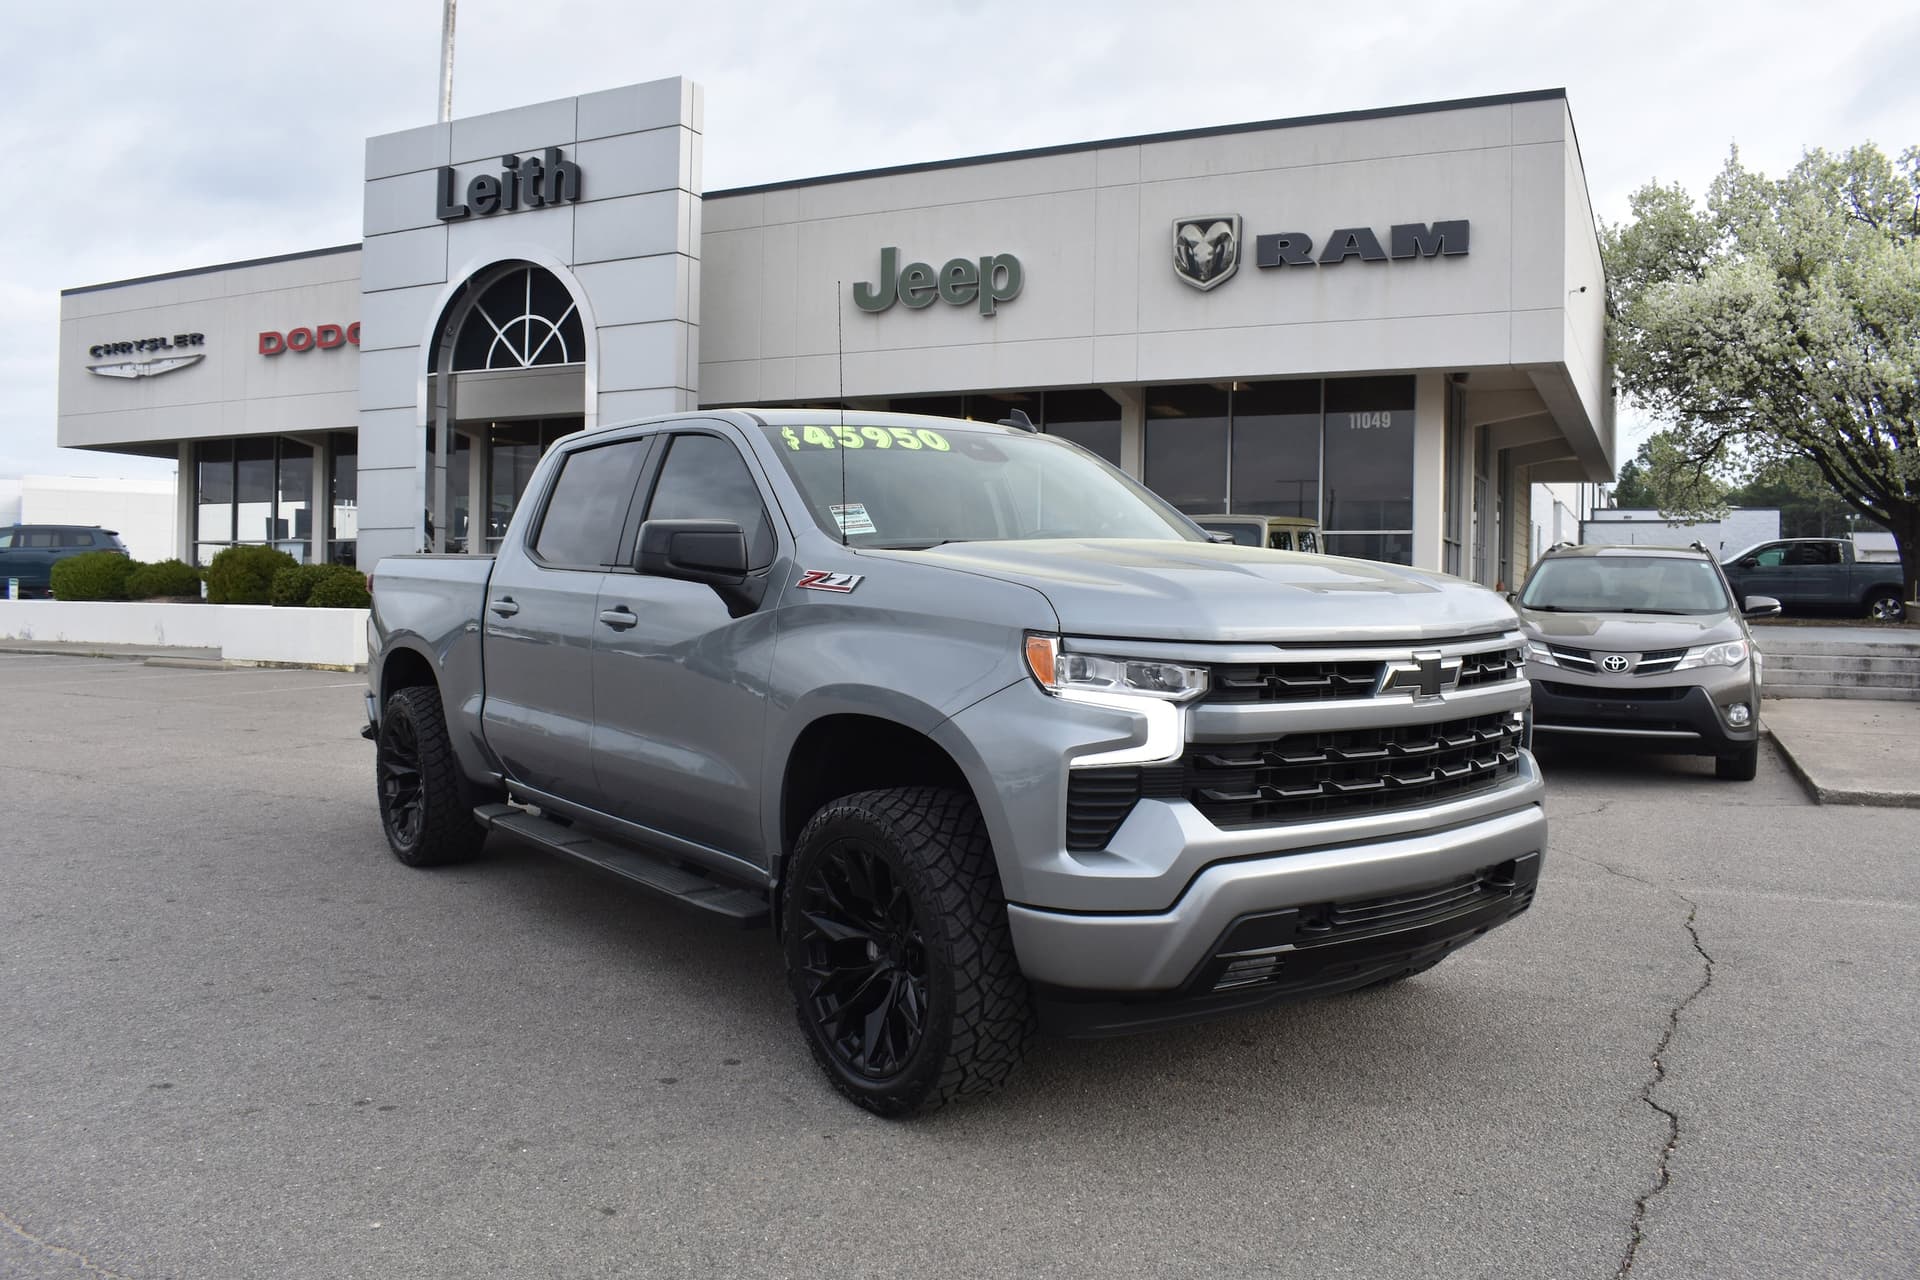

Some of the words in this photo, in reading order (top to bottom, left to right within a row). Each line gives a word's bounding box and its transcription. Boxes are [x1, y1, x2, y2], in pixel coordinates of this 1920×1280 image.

[437, 146, 581, 221] Leith
[1256, 219, 1469, 268] RAM
[853, 246, 1022, 316] Jeep
[89, 332, 205, 358] CHRYSLER
[1349, 410, 1391, 429] 11049
[781, 425, 950, 451] $45950
[796, 569, 865, 594] Z71
